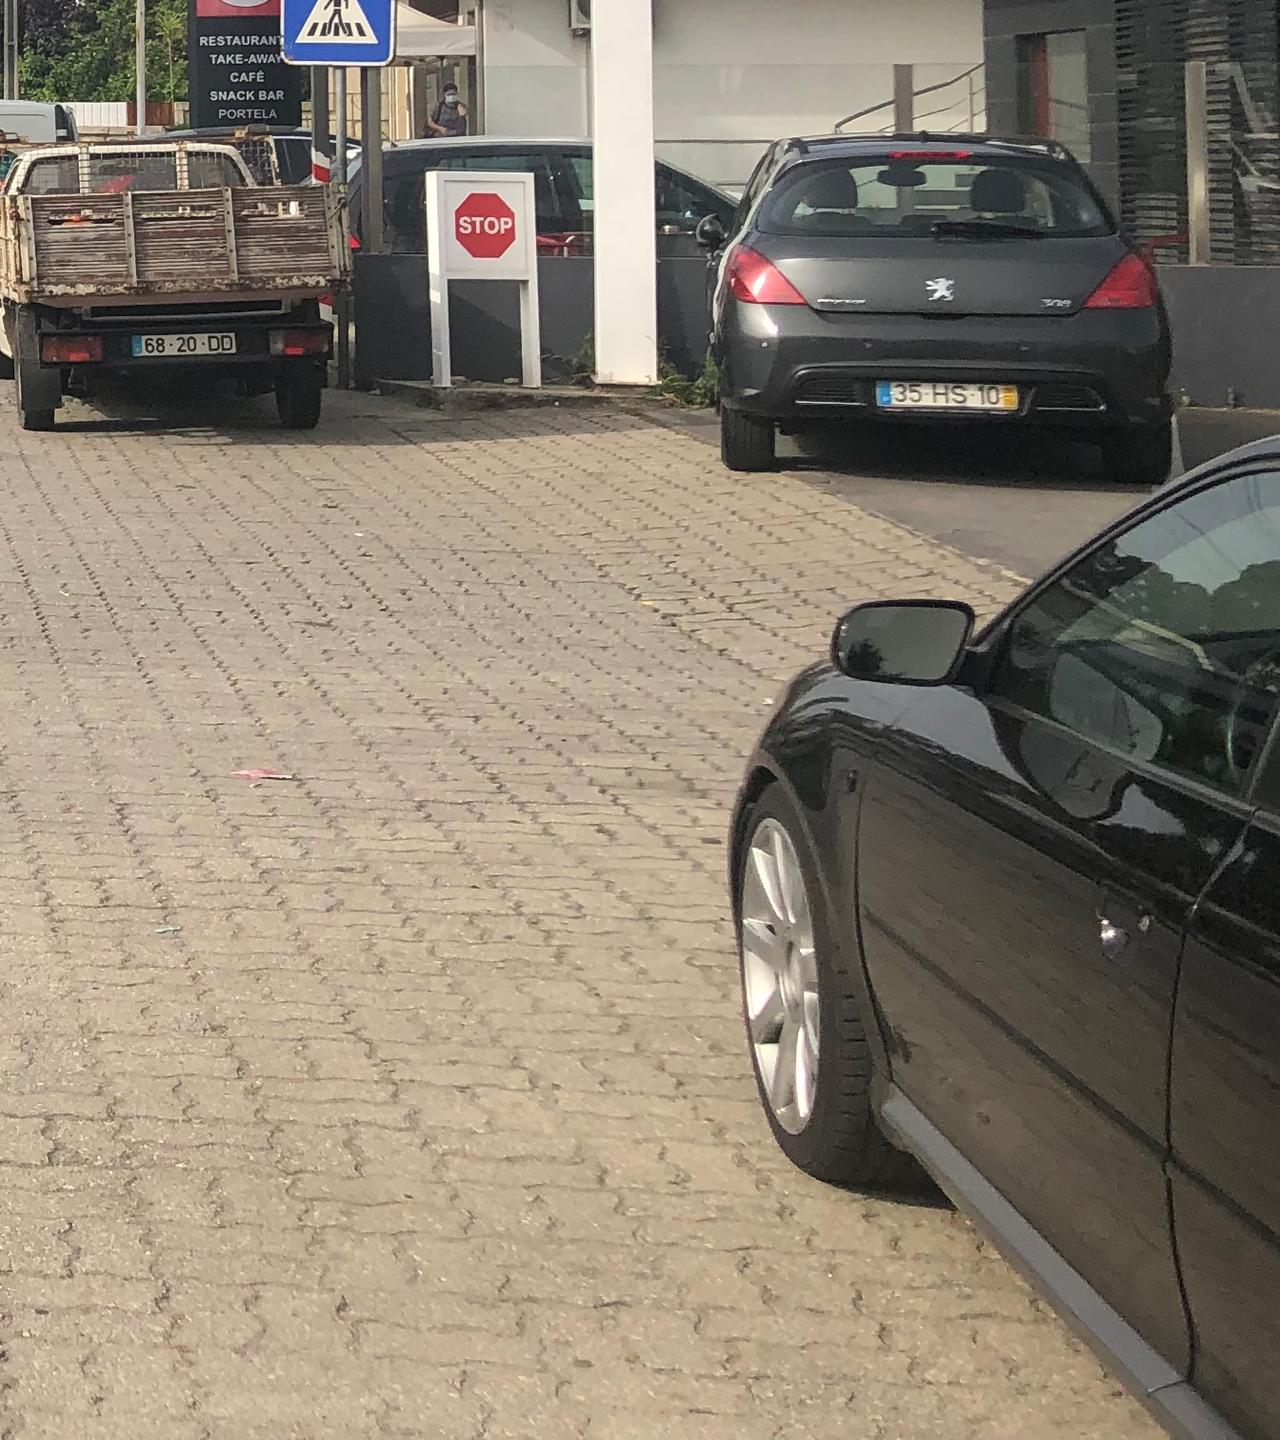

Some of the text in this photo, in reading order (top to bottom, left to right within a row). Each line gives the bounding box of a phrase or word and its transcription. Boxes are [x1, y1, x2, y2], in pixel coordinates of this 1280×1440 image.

[209, 54, 281, 64] TAKE-AWAY
[229, 70, 265, 83] CAFÉ
[209, 90, 285, 101] SNACK BAR
[218, 109, 277, 120] PORTELA
[459, 216, 513, 235] STOP
